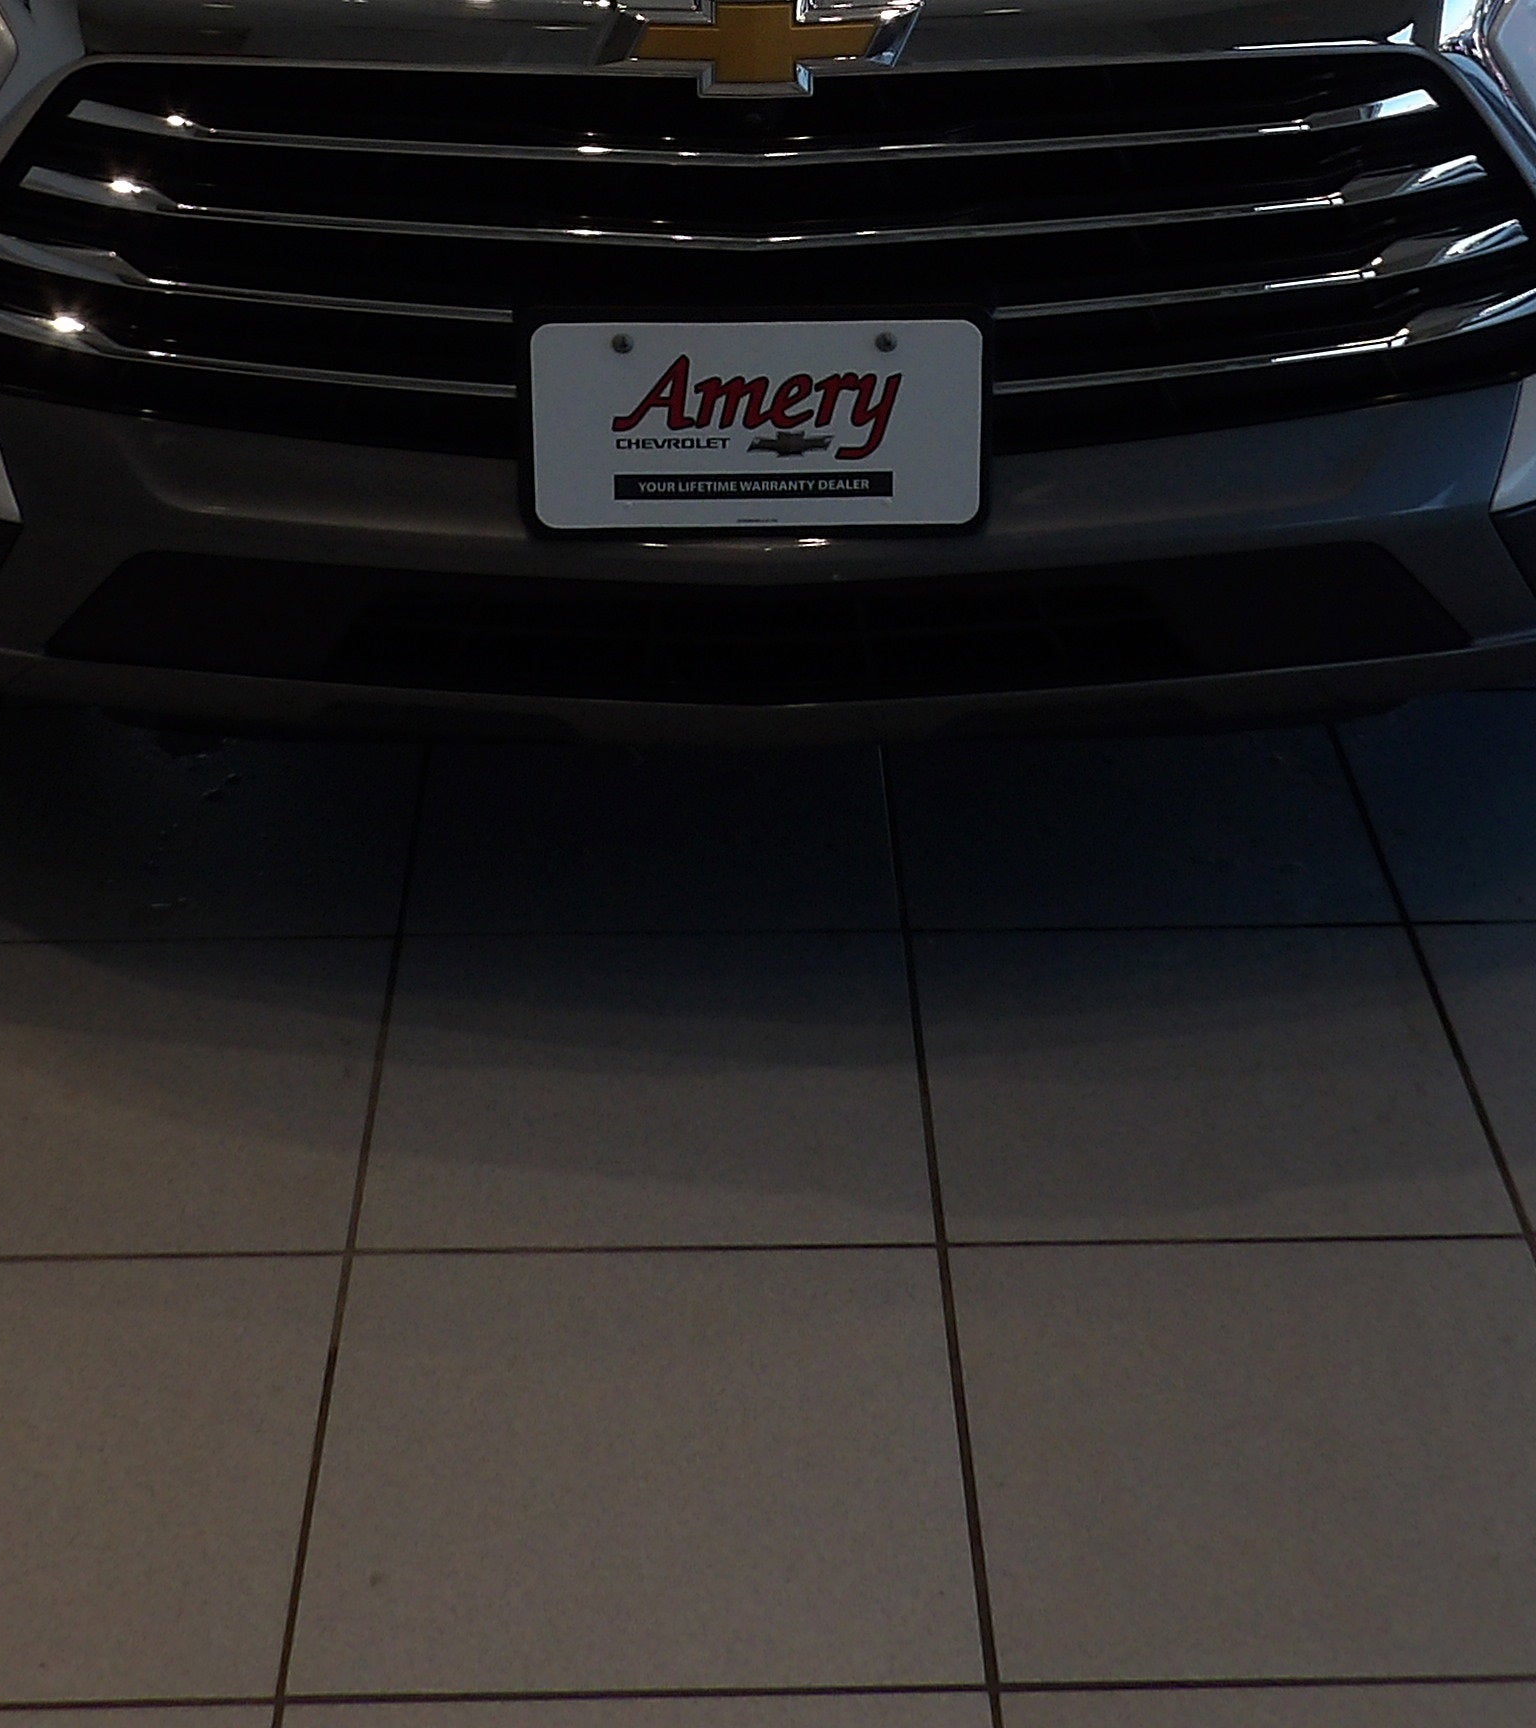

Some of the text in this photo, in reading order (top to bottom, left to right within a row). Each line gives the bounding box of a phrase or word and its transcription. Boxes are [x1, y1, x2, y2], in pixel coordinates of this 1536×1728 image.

[612, 353, 902, 460] Amery
[615, 437, 731, 450] CHEVROLET
[637, 478, 870, 492] YOUR LIFETIME WARRANTY DEALER
